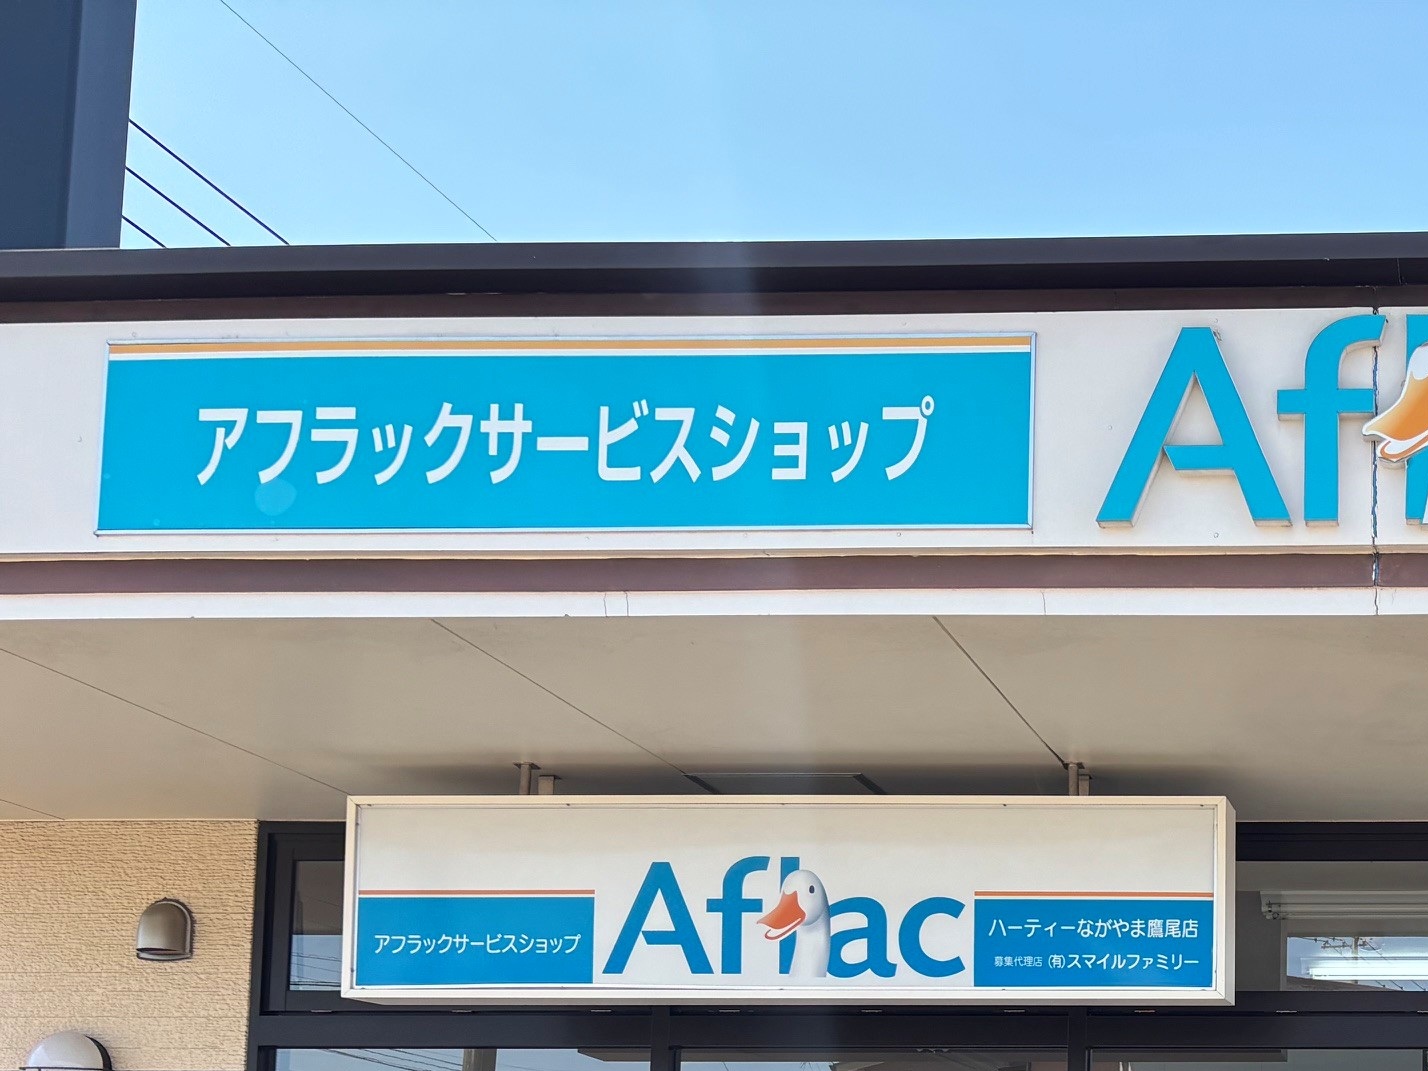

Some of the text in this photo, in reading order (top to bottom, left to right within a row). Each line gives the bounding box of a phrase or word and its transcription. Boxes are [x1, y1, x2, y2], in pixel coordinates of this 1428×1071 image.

[196, 394, 937, 486] アフラックサービスショップ
[988, 918, 1200, 939] ハーティーながやま鷹尾店
[374, 929, 582, 957] アフラックサービスショップ
[993, 956, 1043, 968] 募集代理店
